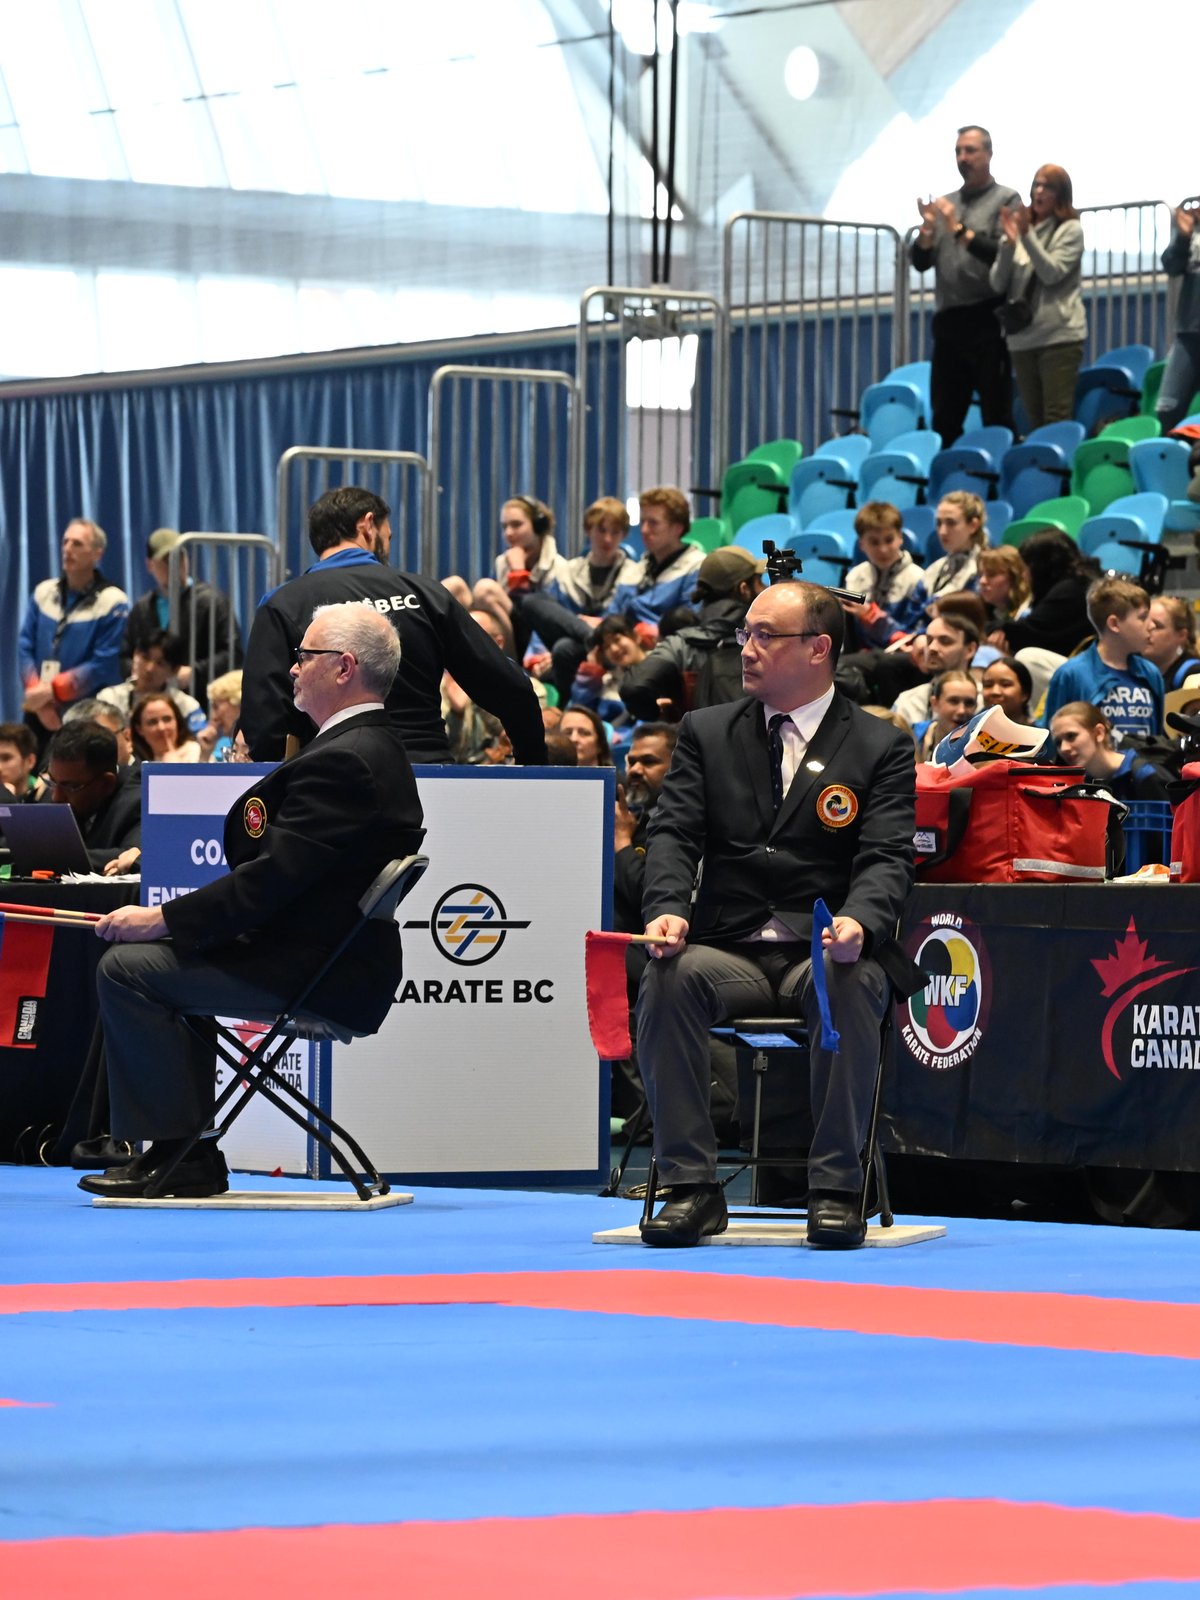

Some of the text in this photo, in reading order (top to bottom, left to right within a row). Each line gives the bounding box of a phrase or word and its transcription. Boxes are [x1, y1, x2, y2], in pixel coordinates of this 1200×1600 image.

[362, 594, 420, 614] BEC
[1103, 686, 1152, 704] ARAT
[1101, 705, 1152, 718] OVA SCO
[190, 839, 228, 866] CO
[931, 913, 963, 930] WORLD
[393, 979, 554, 1004] ARATE BC
[924, 974, 968, 1007] WKF
[901, 1024, 983, 1069] KARATE FEDERATION
